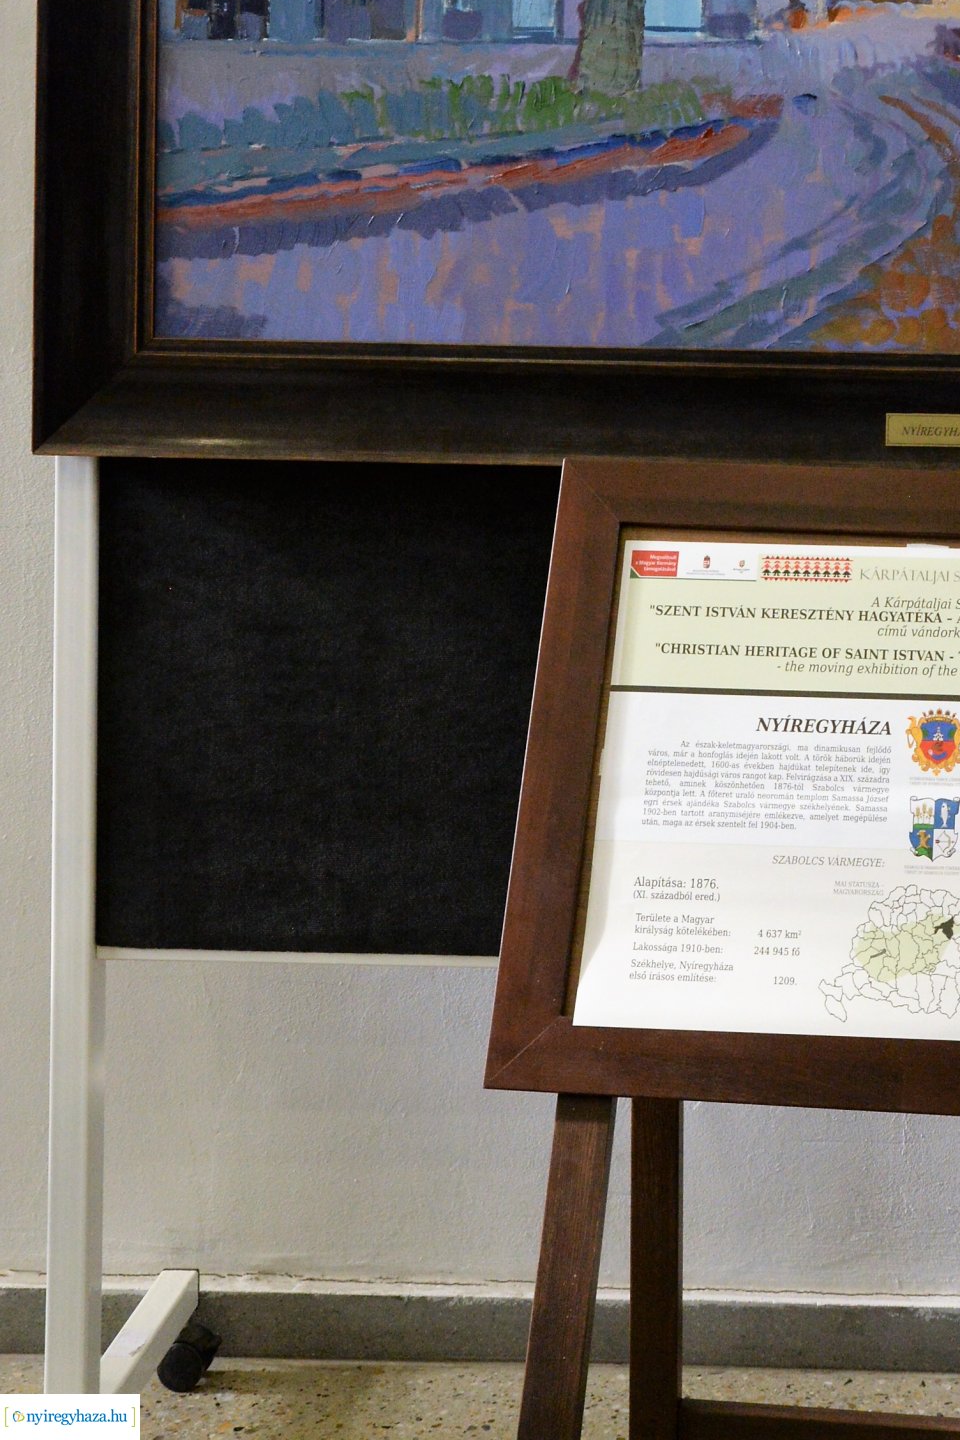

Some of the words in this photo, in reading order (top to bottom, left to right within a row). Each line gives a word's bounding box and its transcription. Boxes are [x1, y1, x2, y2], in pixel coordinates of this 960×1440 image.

[859, 566, 950, 584] KÁRPÁTALJAI
[884, 596, 951, 612] Kárpátaljai
[649, 606, 702, 618] "SZENT
[705, 604, 756, 619] ISTVÁN
[761, 606, 854, 621] KERESZTÉNY
[858, 608, 943, 623] HAGYATÉKA
[877, 624, 908, 637] című
[655, 643, 740, 657] "CHRISTIAN
[745, 645, 817, 658] HERITAGE
[821, 647, 841, 659] OF
[844, 648, 889, 660] SAINT
[892, 649, 945, 661] ISTVAN
[784, 660, 805, 672] the
[808, 661, 853, 676] moving
[857, 662, 918, 675] exhibition
[921, 663, 936, 678] of
[937, 664, 958, 676] the
[756, 714, 890, 734] NYÍREGYHÁZA
[772, 855, 825, 865] SZABOLCS
[827, 854, 885, 866] VÁRMEGYE:
[634, 876, 686, 890] Alapítása:
[688, 877, 718, 888] 1876.
[632, 890, 648, 900] (XI.
[650, 890, 692, 900] századból
[694, 891, 720, 902] ered.)
[635, 913, 671, 922] Területe
[681, 914, 714, 925] Magyar
[634, 924, 674, 937] királyság
[765, 929, 782, 938] 637
[632, 942, 678, 953] Lakossága
[679, 943, 723, 952] 1910-ben:
[753, 946, 770, 955] 244
[772, 946, 789, 955] 945
[791, 946, 800, 955] fő
[630, 958, 677, 971] Székhelye,
[678, 959, 733, 972] Nyíregyháza
[628, 970, 646, 980] első
[648, 971, 675, 981] írásos
[677, 971, 716, 982] említése:
[773, 976, 797, 985] 1209.
